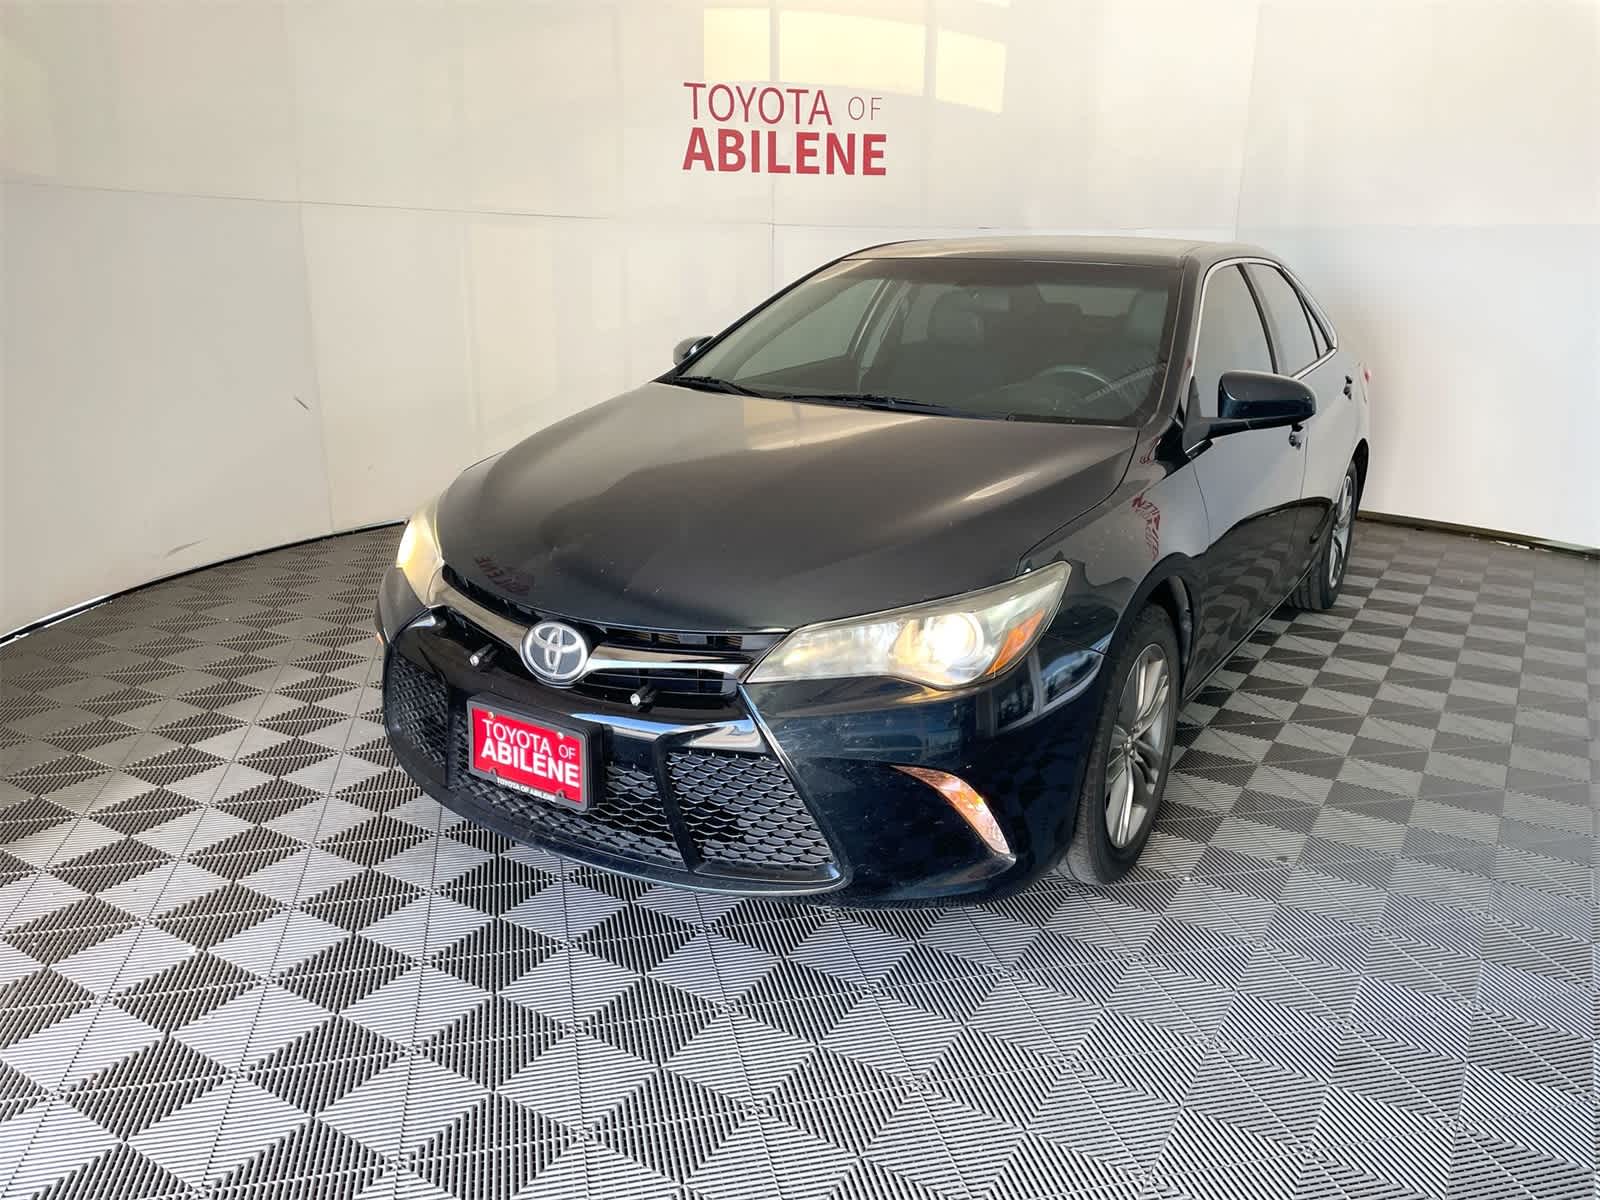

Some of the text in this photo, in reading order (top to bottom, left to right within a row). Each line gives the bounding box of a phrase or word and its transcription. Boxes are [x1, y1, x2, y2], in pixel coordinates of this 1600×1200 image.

[684, 82, 882, 125] TOYOTA OF
[682, 127, 887, 176] ABILENE
[482, 719, 576, 759] TOYOTA OF
[481, 738, 579, 787] ABILENE
